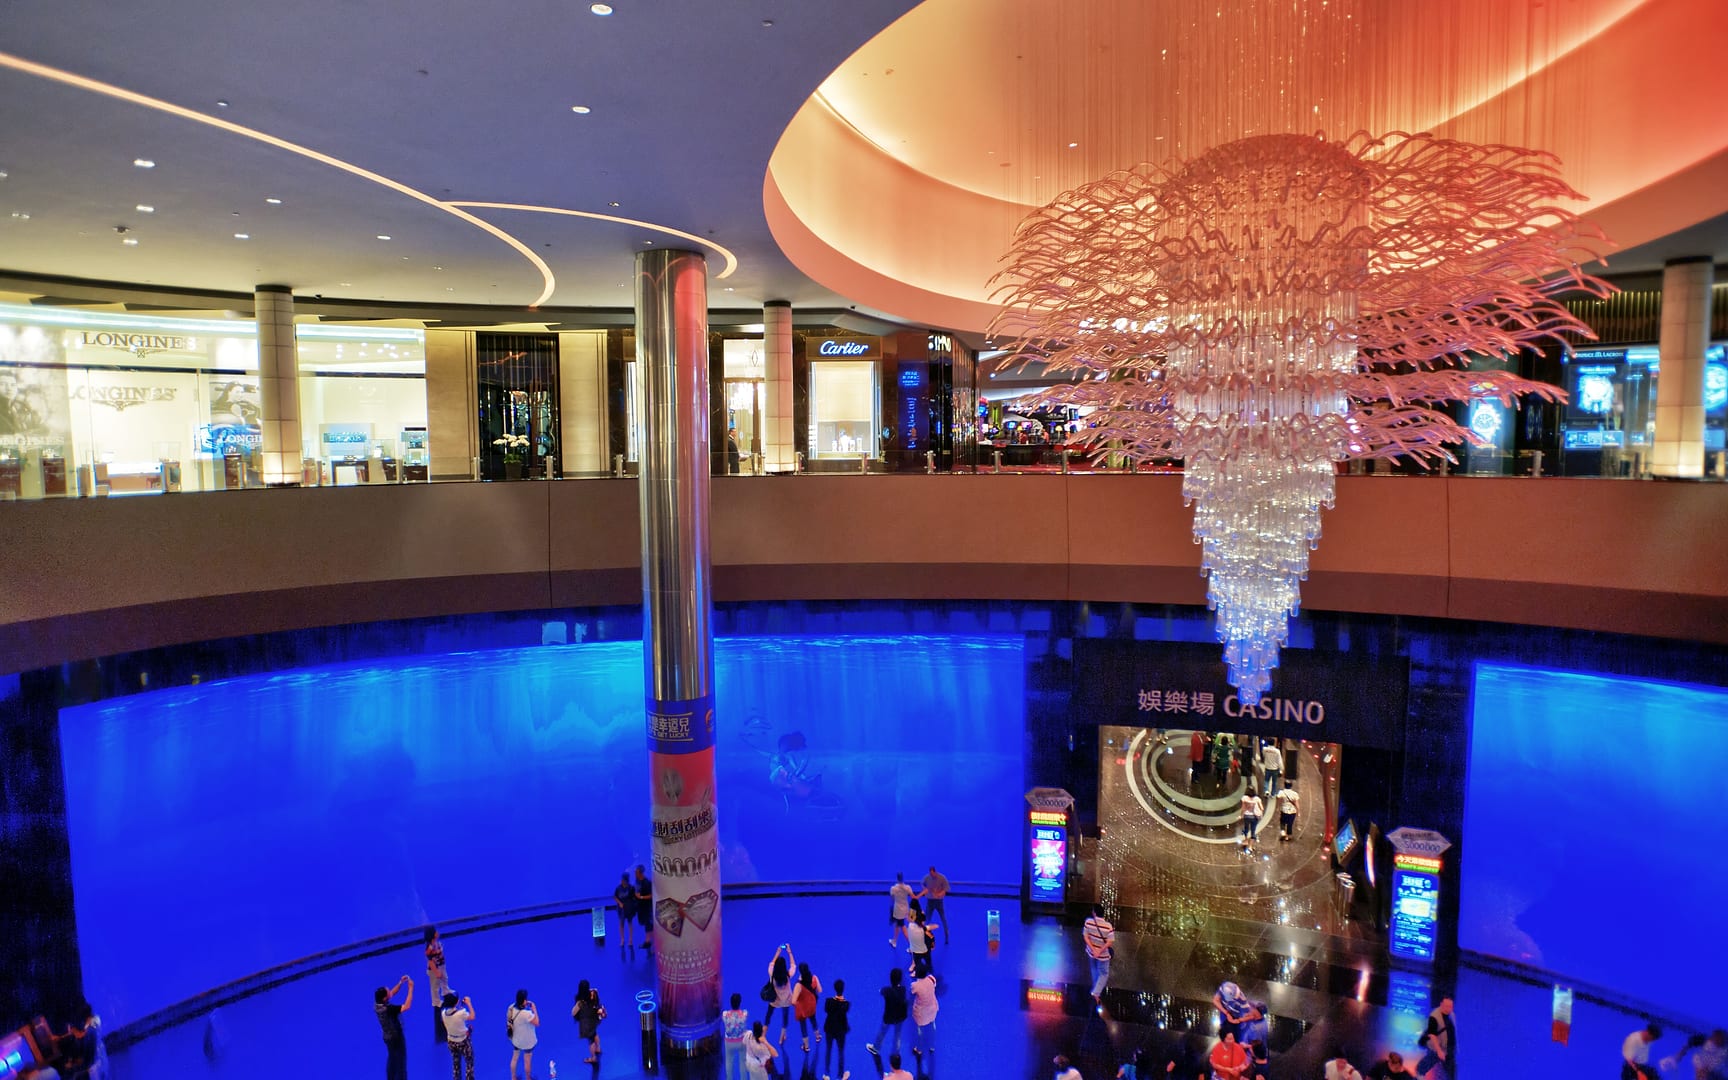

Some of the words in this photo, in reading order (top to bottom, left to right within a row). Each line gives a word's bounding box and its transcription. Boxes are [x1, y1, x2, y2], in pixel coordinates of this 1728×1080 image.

[820, 341, 868, 355] Cartier
[1138, 689, 1215, 716] 娛樂場
[1224, 695, 1325, 725] CASINO
